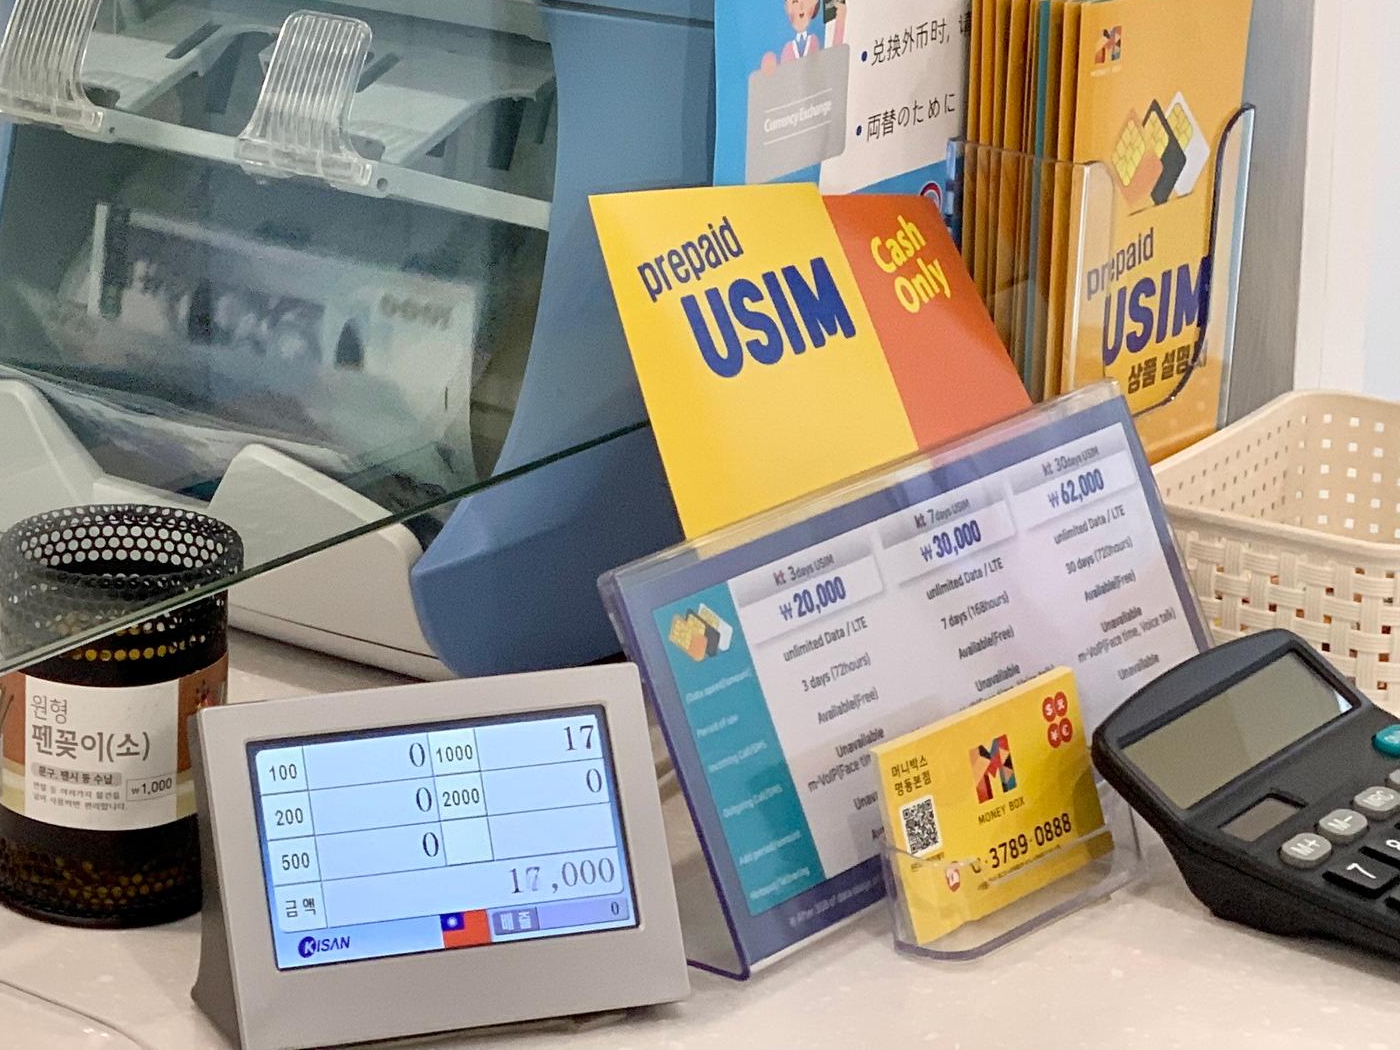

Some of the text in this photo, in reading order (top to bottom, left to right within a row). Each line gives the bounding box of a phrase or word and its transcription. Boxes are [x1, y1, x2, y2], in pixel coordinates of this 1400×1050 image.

[866, 93, 956, 142] 両替のために
[637, 216, 744, 303] prepaid
[871, 215, 927, 274] Cash
[894, 257, 952, 314] Only
[681, 257, 857, 378] USIM
[1102, 254, 1212, 366] USIM
[1128, 357, 1157, 394] 상품
[1054, 522, 1089, 545] unlimited
[1089, 514, 1107, 530] Data
[1111, 504, 1125, 519] LTE
[926, 574, 964, 600] unlimited
[964, 568, 983, 585] Data
[989, 558, 1004, 574] LTE
[1076, 551, 1095, 570] days
[940, 617, 947, 630] 7
[949, 612, 968, 628] days
[1101, 605, 1142, 633] Unavailable
[784, 633, 825, 662] unlimited
[826, 625, 846, 645] Data
[853, 616, 868, 632] LTE
[802, 652, 871, 692] 3 days (72hours)
[975, 663, 1021, 692] Unavailable
[31, 694, 68, 725] 원형
[31, 724, 151, 763] 펜꽂이(소)
[268, 724, 595, 782] 100 0 1000 17
[835, 728, 884, 758] Unavailable
[891, 755, 928, 778] 머니박스
[894, 770, 932, 797] 명동본점
[275, 768, 603, 826] 200 0 2000 0
[978, 796, 1025, 825] MONEY BOX
[281, 832, 440, 871] 500 0
[1346, 862, 1377, 880] 7
[298, 901, 620, 959] KISAN 0
